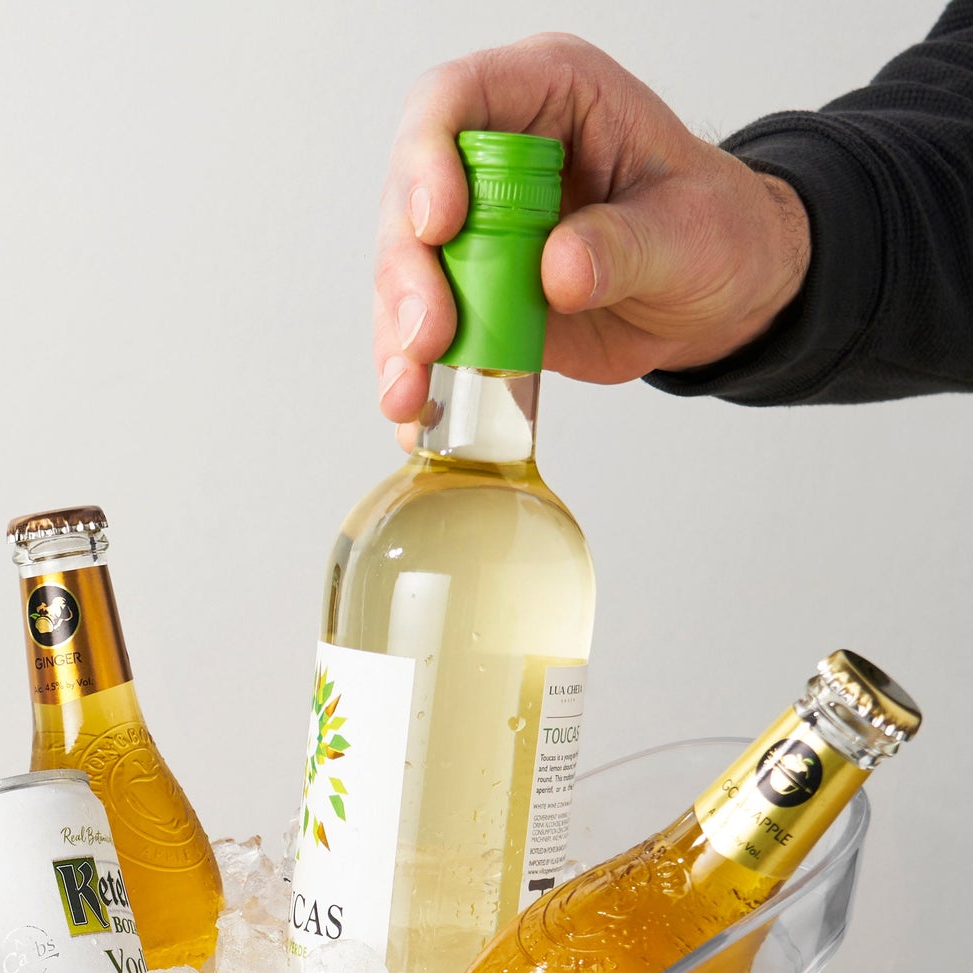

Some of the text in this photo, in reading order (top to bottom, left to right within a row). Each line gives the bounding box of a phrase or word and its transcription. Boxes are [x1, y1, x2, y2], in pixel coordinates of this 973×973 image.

[34, 651, 83, 670] GINGER
[76, 677, 94, 688] Vol.
[542, 725, 580, 745] TOUCAS
[60, 826, 87, 846] Real
[751, 811, 794, 847] APPLE
[744, 841, 762, 861] Vol.
